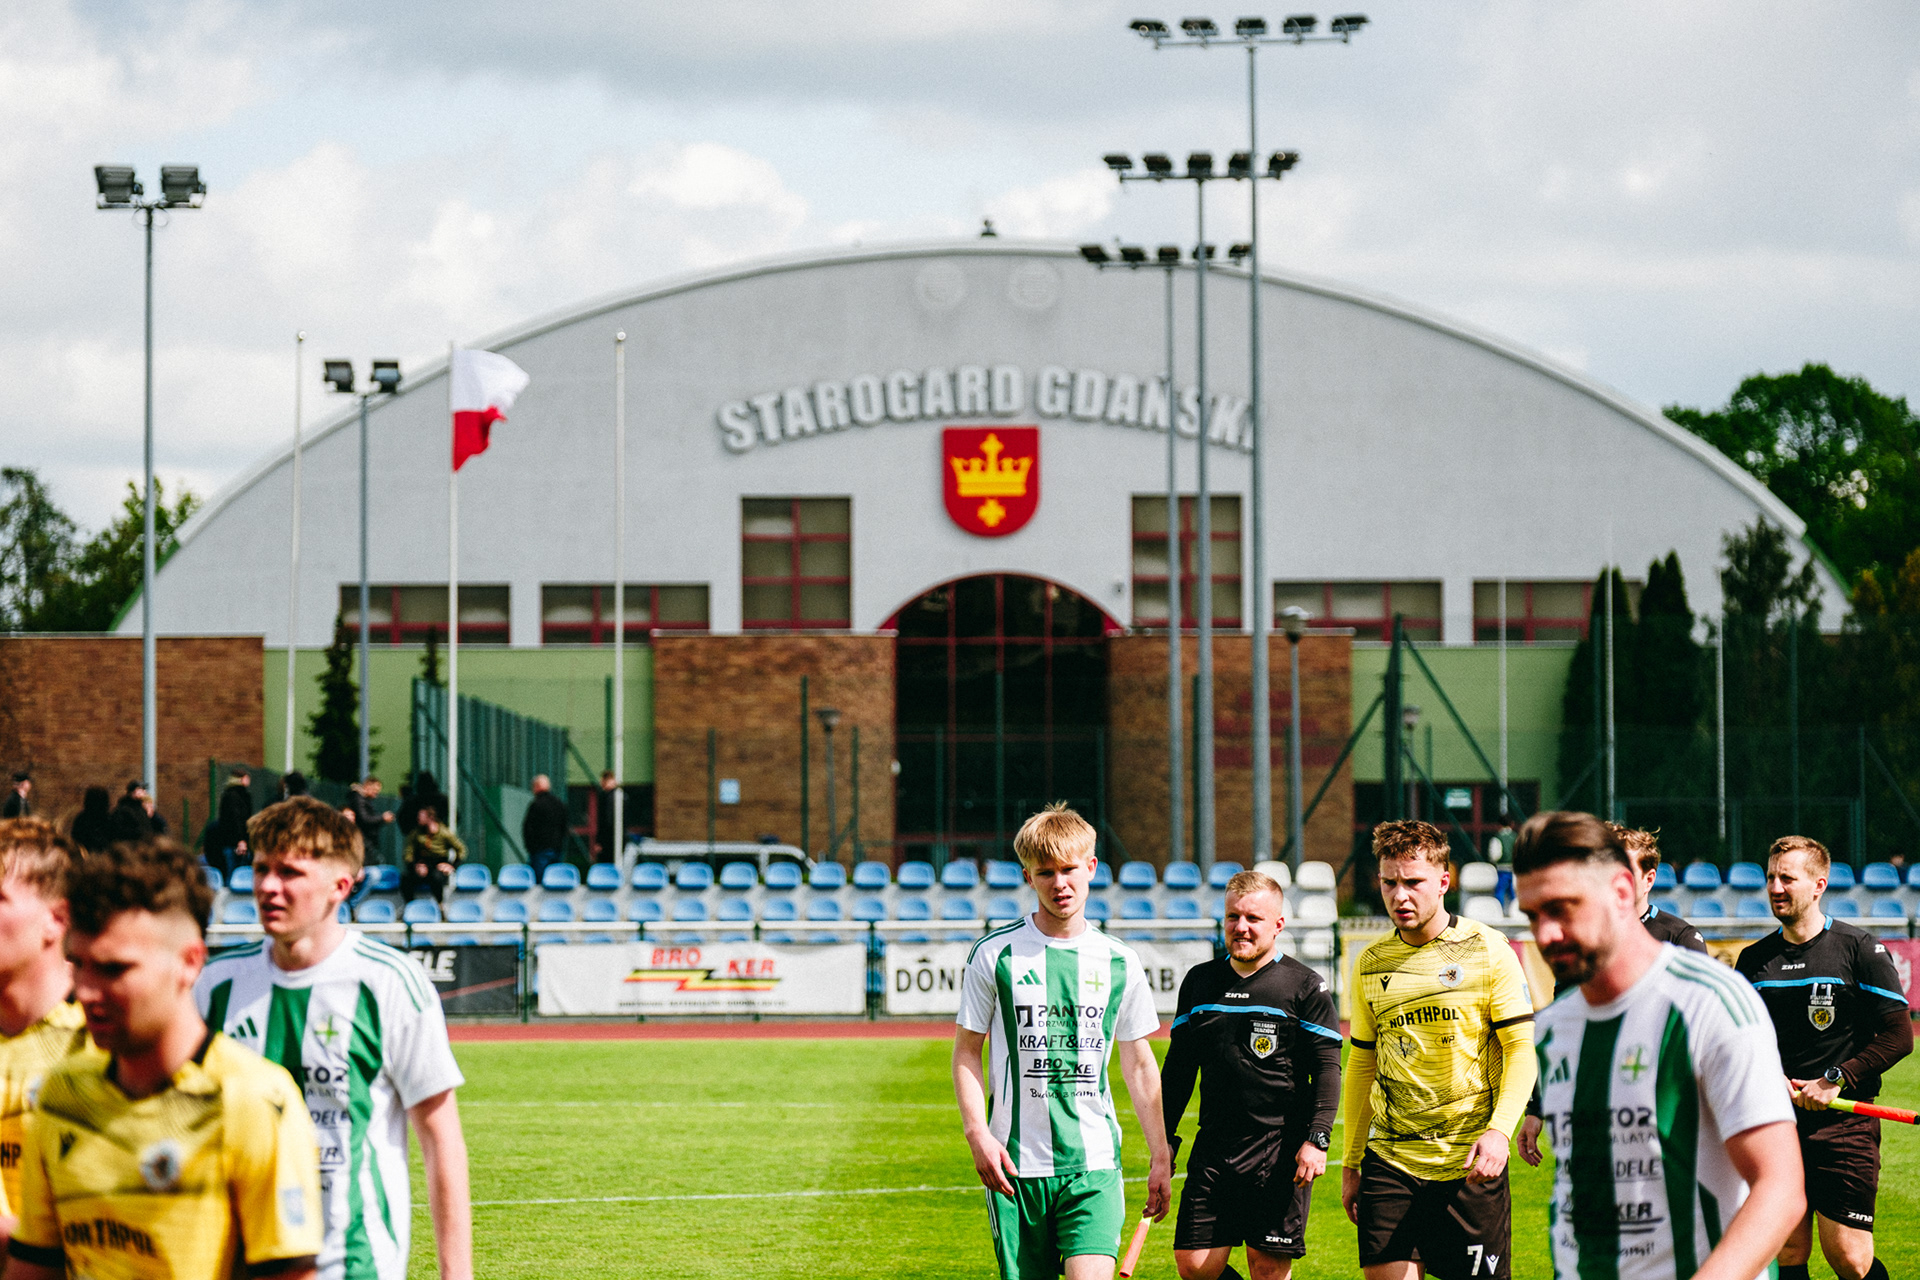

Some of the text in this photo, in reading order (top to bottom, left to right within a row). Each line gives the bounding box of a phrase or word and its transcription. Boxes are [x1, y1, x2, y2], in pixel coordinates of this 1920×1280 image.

[719, 364, 1024, 452] STAROGARD
[651, 948, 774, 977] BRO KER
[1389, 1006, 1459, 1029] NORTHPOL
[1020, 1034, 1104, 1049] KRAFT&DELE
[1033, 1059, 1094, 1074] BRO KE
[1467, 1244, 1483, 1276] 7
